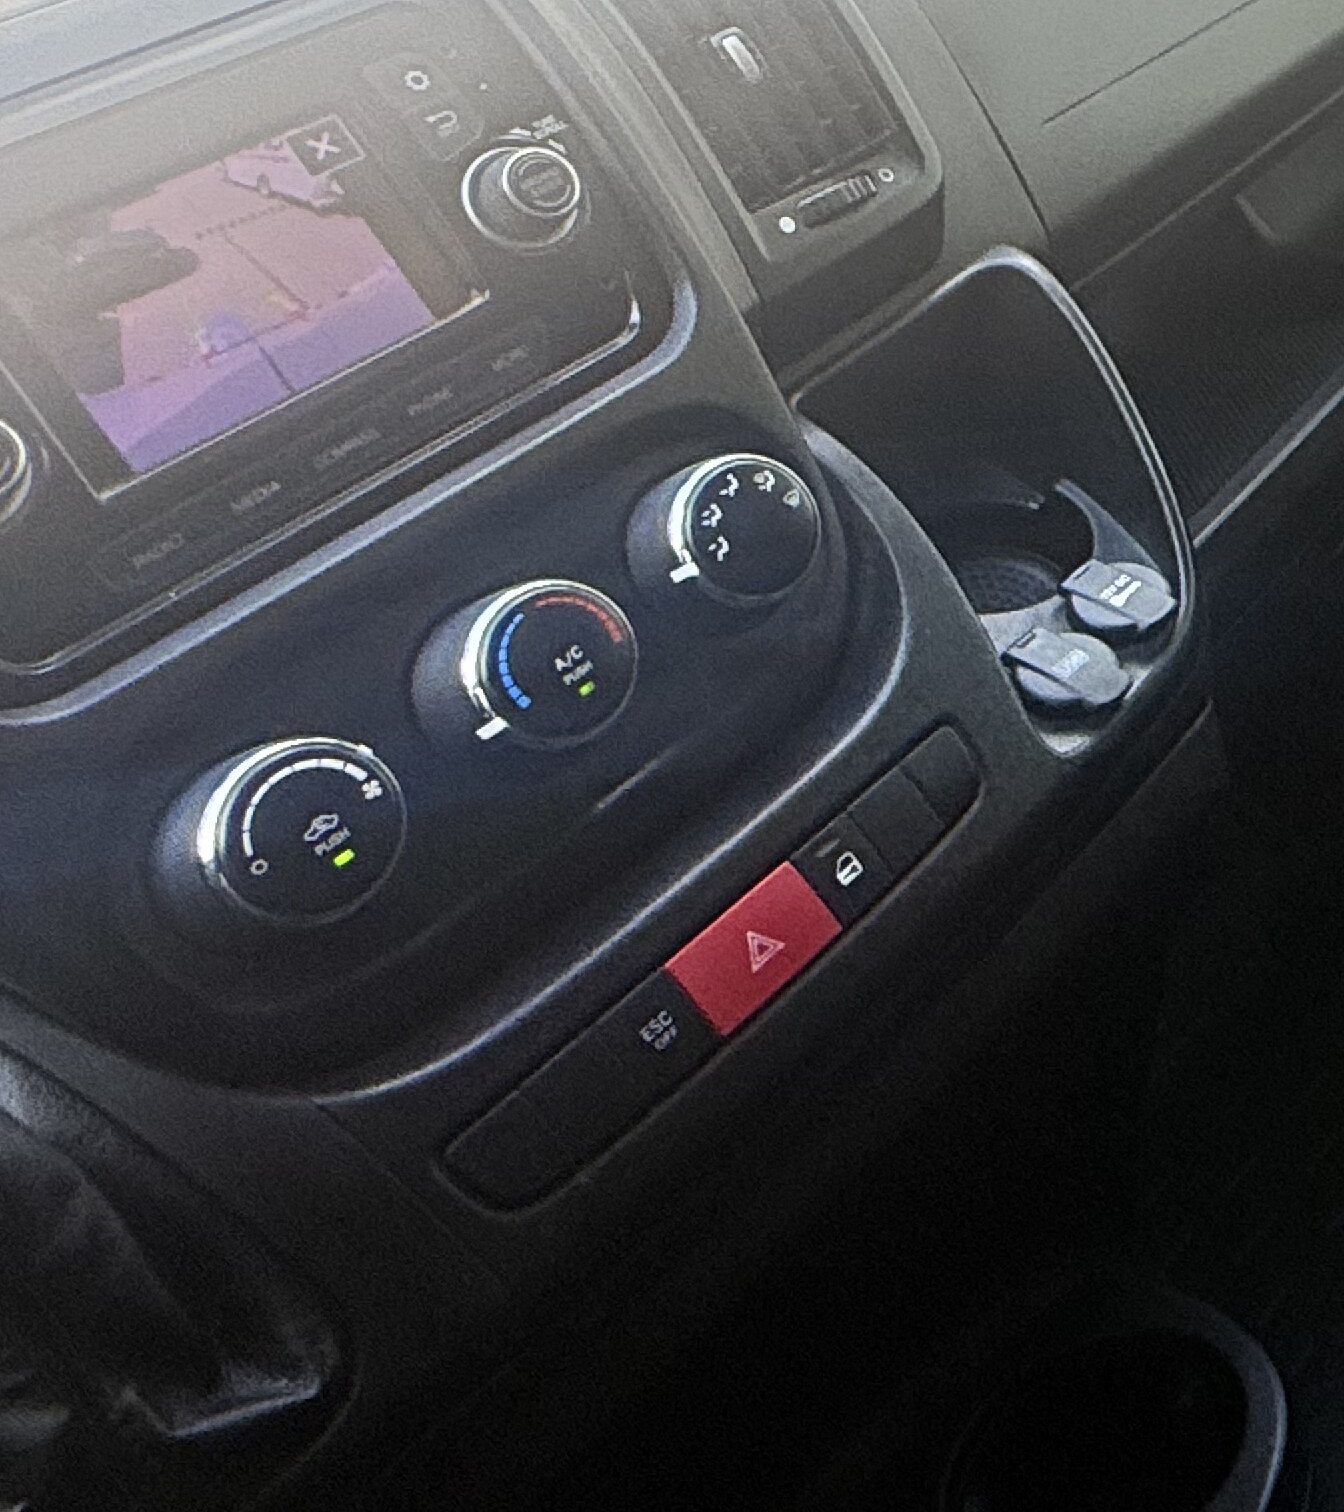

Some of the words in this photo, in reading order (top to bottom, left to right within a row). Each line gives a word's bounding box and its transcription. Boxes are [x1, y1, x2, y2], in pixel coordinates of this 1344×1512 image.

[554, 644, 584, 672] A/C
[639, 1010, 674, 1042] ESC
[654, 1025, 678, 1051] OFF
